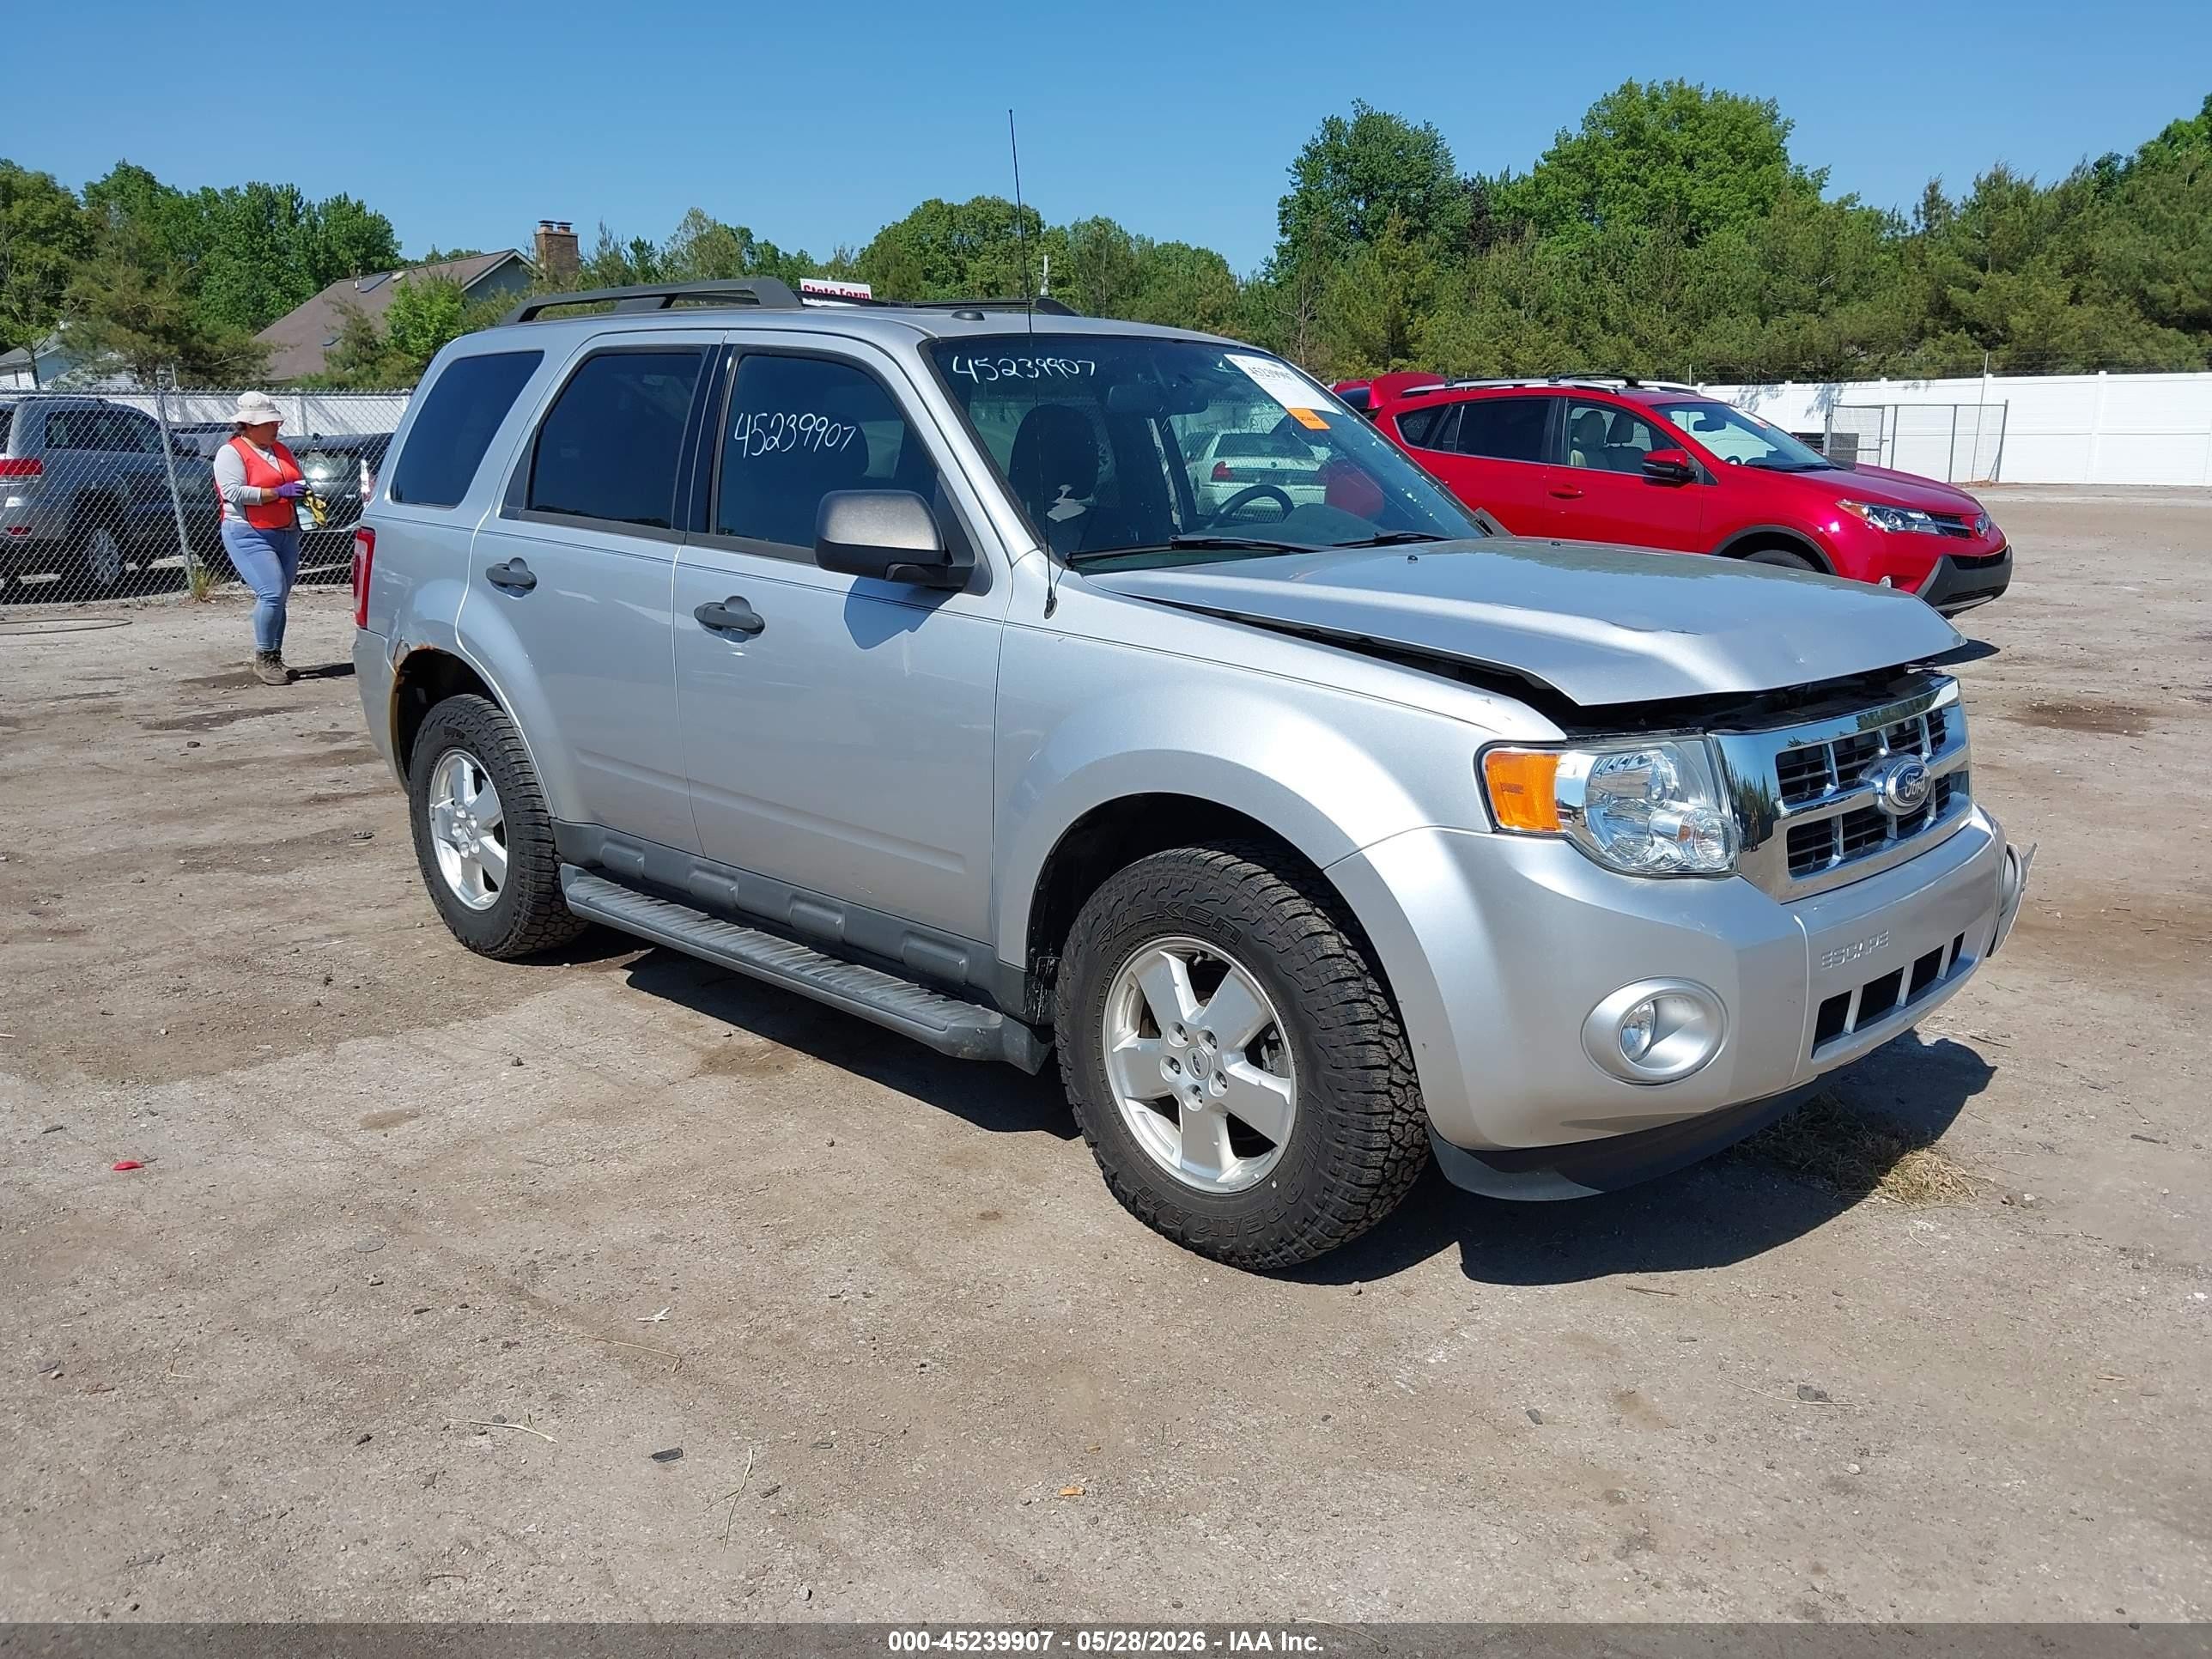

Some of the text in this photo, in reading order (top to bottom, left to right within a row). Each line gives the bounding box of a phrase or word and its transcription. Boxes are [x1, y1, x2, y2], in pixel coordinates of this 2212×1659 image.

[952, 356, 1096, 384] 45239907
[734, 412, 857, 459] 45239907
[1820, 928, 1889, 970] ESCAPE
